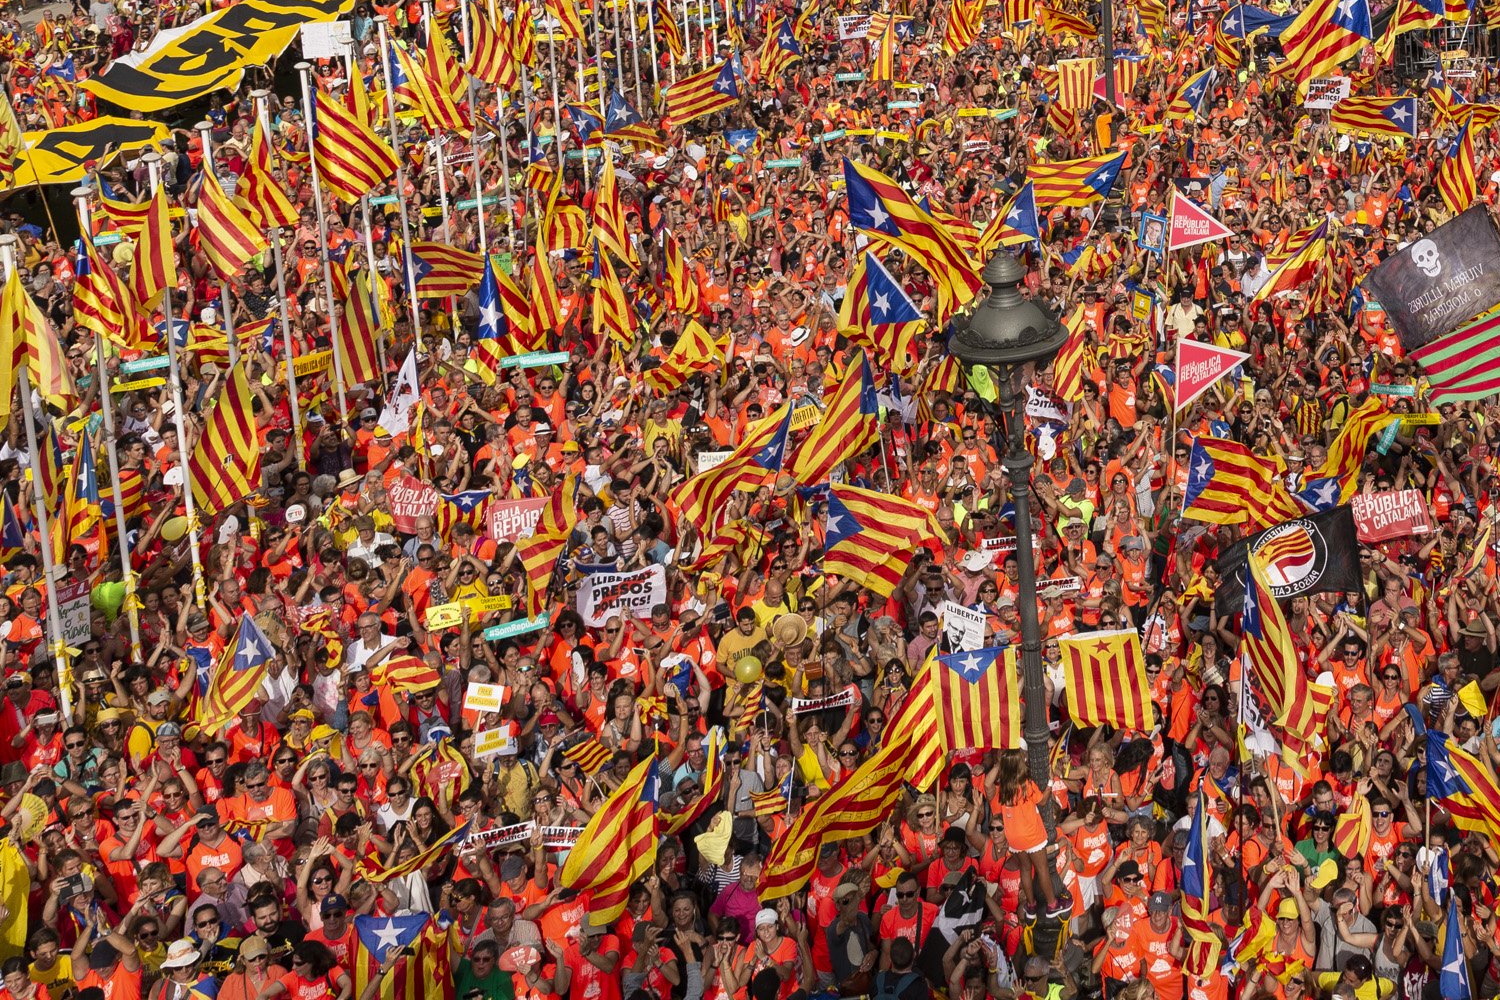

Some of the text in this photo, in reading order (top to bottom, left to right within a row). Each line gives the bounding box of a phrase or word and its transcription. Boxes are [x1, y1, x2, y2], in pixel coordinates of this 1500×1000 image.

[1309, 86, 1341, 95] PRESOS
[1174, 219, 1210, 229] REPÚBLICA
[1184, 228, 1210, 236] CATALANA
[293, 360, 319, 376] EPÚBLICA
[1180, 354, 1222, 384] REPÚBLICA
[1192, 365, 1222, 386] CATALANA
[791, 405, 817, 427] LIBERTAT
[391, 484, 439, 504] PÚBLICA
[494, 506, 520, 520] FEM LA
[1352, 488, 1418, 522] REPÚBLICA
[493, 508, 544, 539] REPÚB
[1373, 506, 1423, 531] CATALANA
[987, 539, 1018, 547] LLIBER
[592, 571, 654, 587] LLIBERTAT
[1036, 579, 1075, 590] LIBERTAT
[592, 581, 653, 602] PRESOS
[593, 596, 651, 612] POLÍTICS!
[947, 604, 984, 624] LLIBERTAT
[476, 686, 493, 697] FREE
[484, 730, 500, 741] FREE
